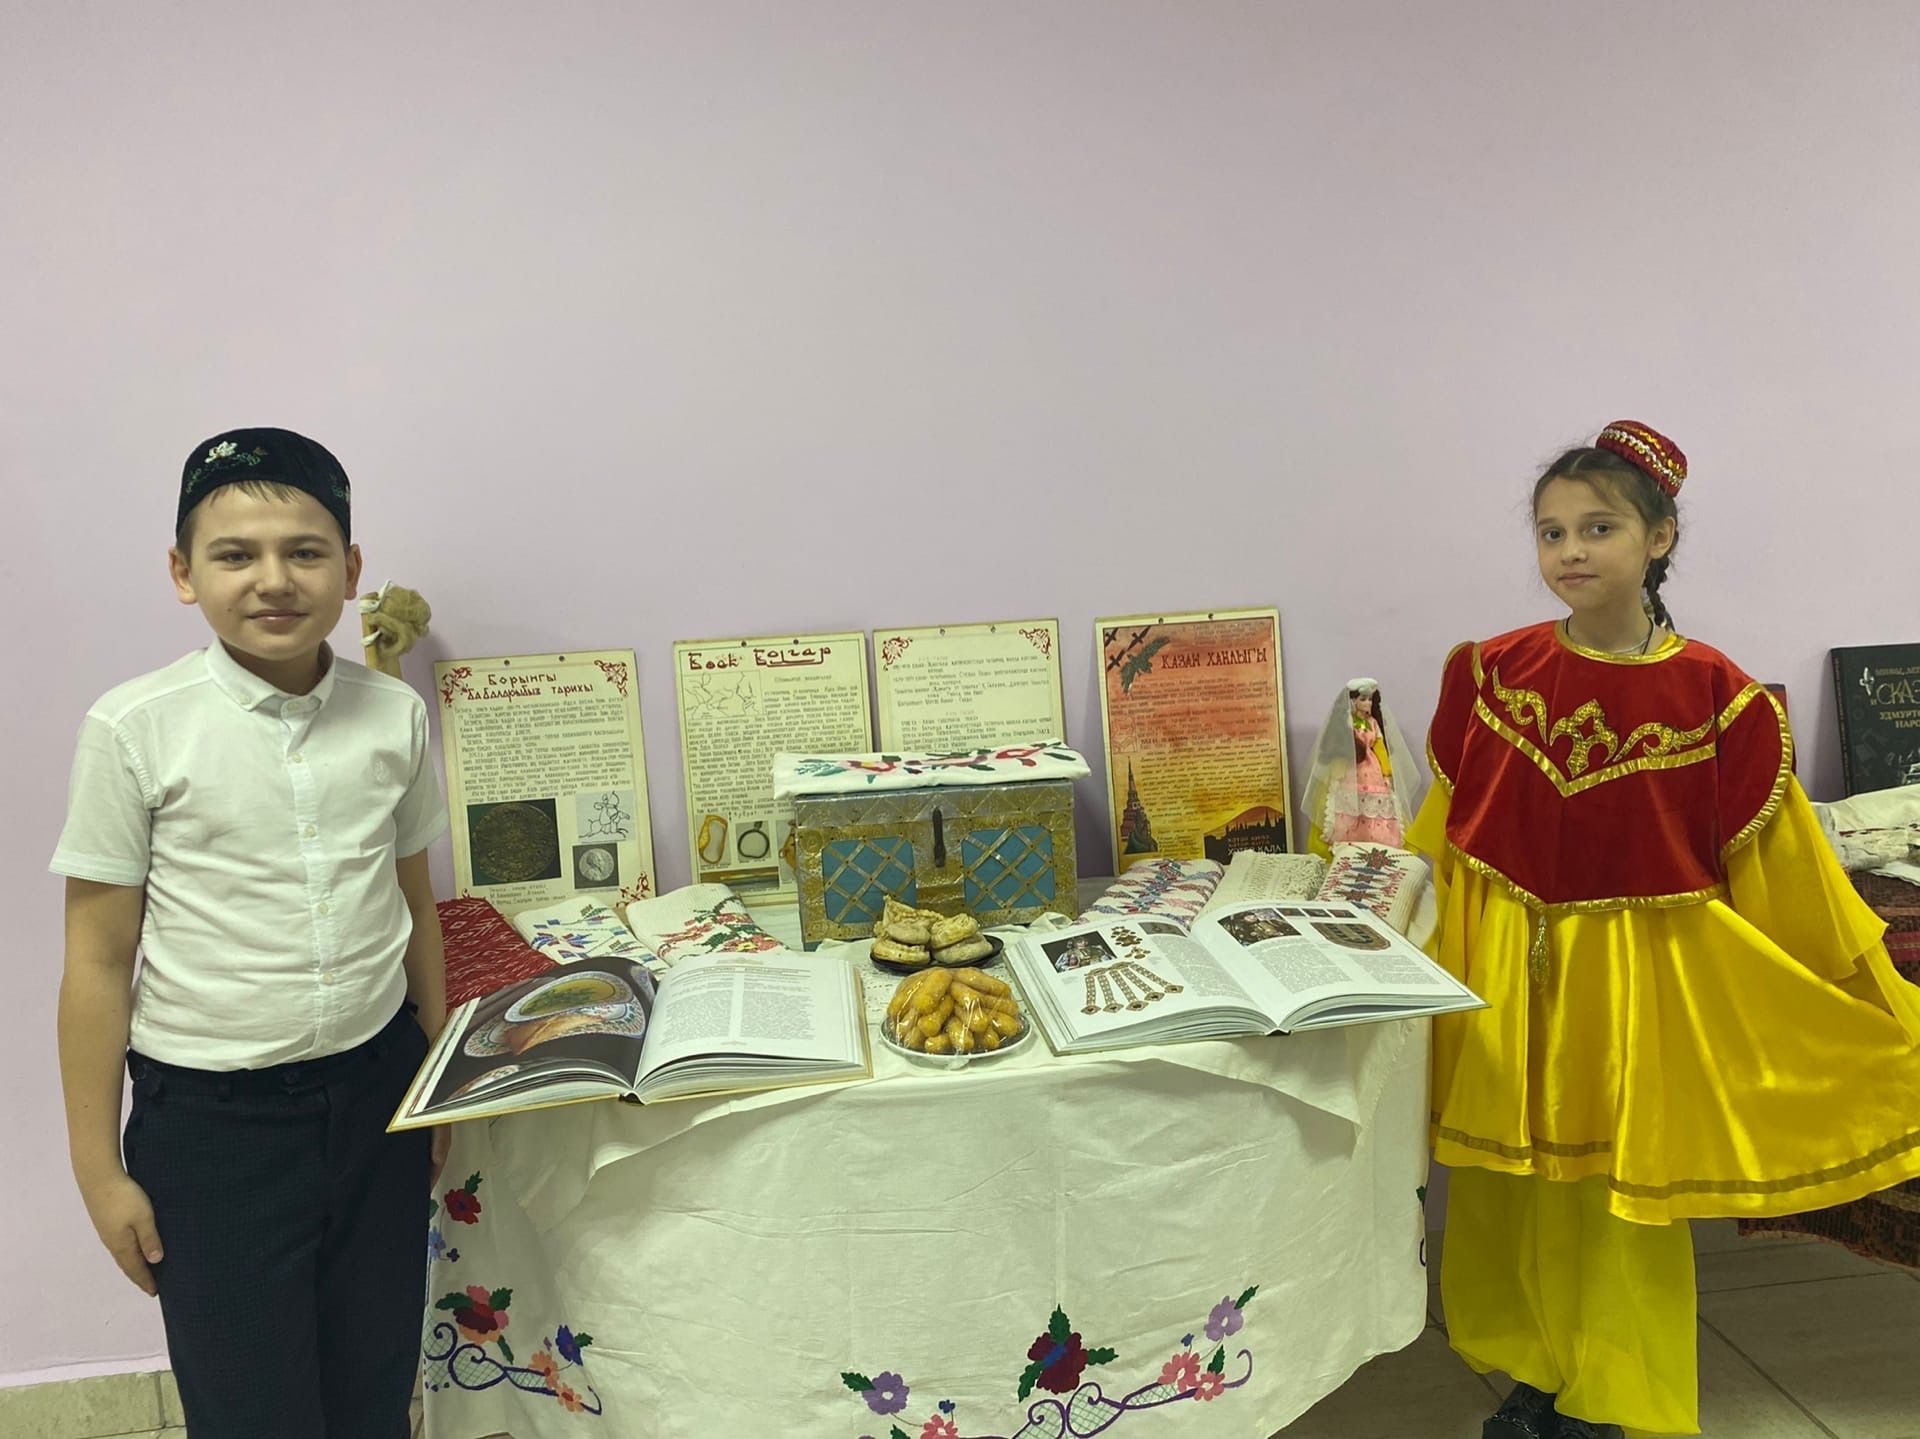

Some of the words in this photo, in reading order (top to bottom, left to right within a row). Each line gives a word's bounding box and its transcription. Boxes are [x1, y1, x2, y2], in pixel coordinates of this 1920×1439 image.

[1161, 652, 1201, 670] КАЗАН
[487, 673, 557, 689] Борынгы
[551, 684, 594, 697] тарихы
